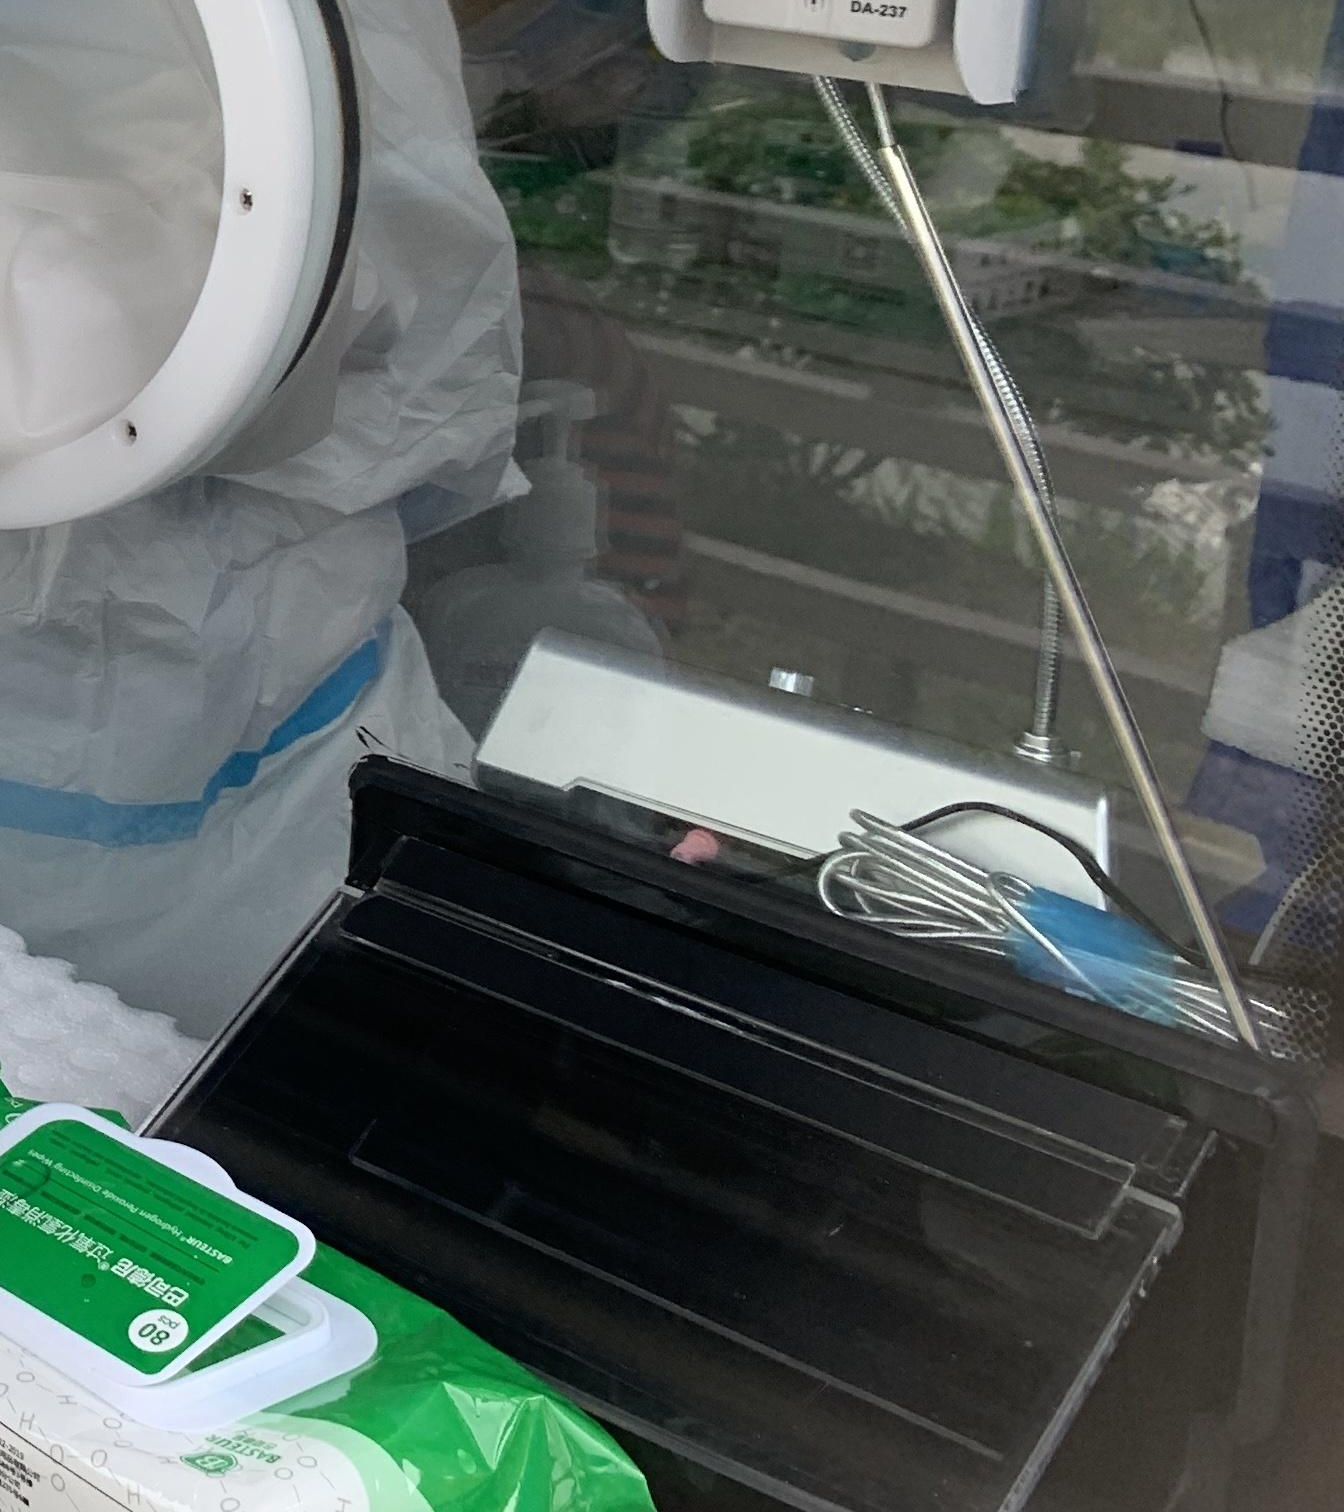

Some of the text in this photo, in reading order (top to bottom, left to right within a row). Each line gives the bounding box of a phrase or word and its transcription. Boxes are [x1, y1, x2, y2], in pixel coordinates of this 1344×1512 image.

[27, 1148, 53, 1167] Wipes
[52, 1162, 102, 1193] Disinfecting
[101, 1189, 139, 1214] Peroxide
[138, 1209, 183, 1237] Hydrogen
[157, 1314, 180, 1330] pcs
[138, 1323, 170, 1346] 80
